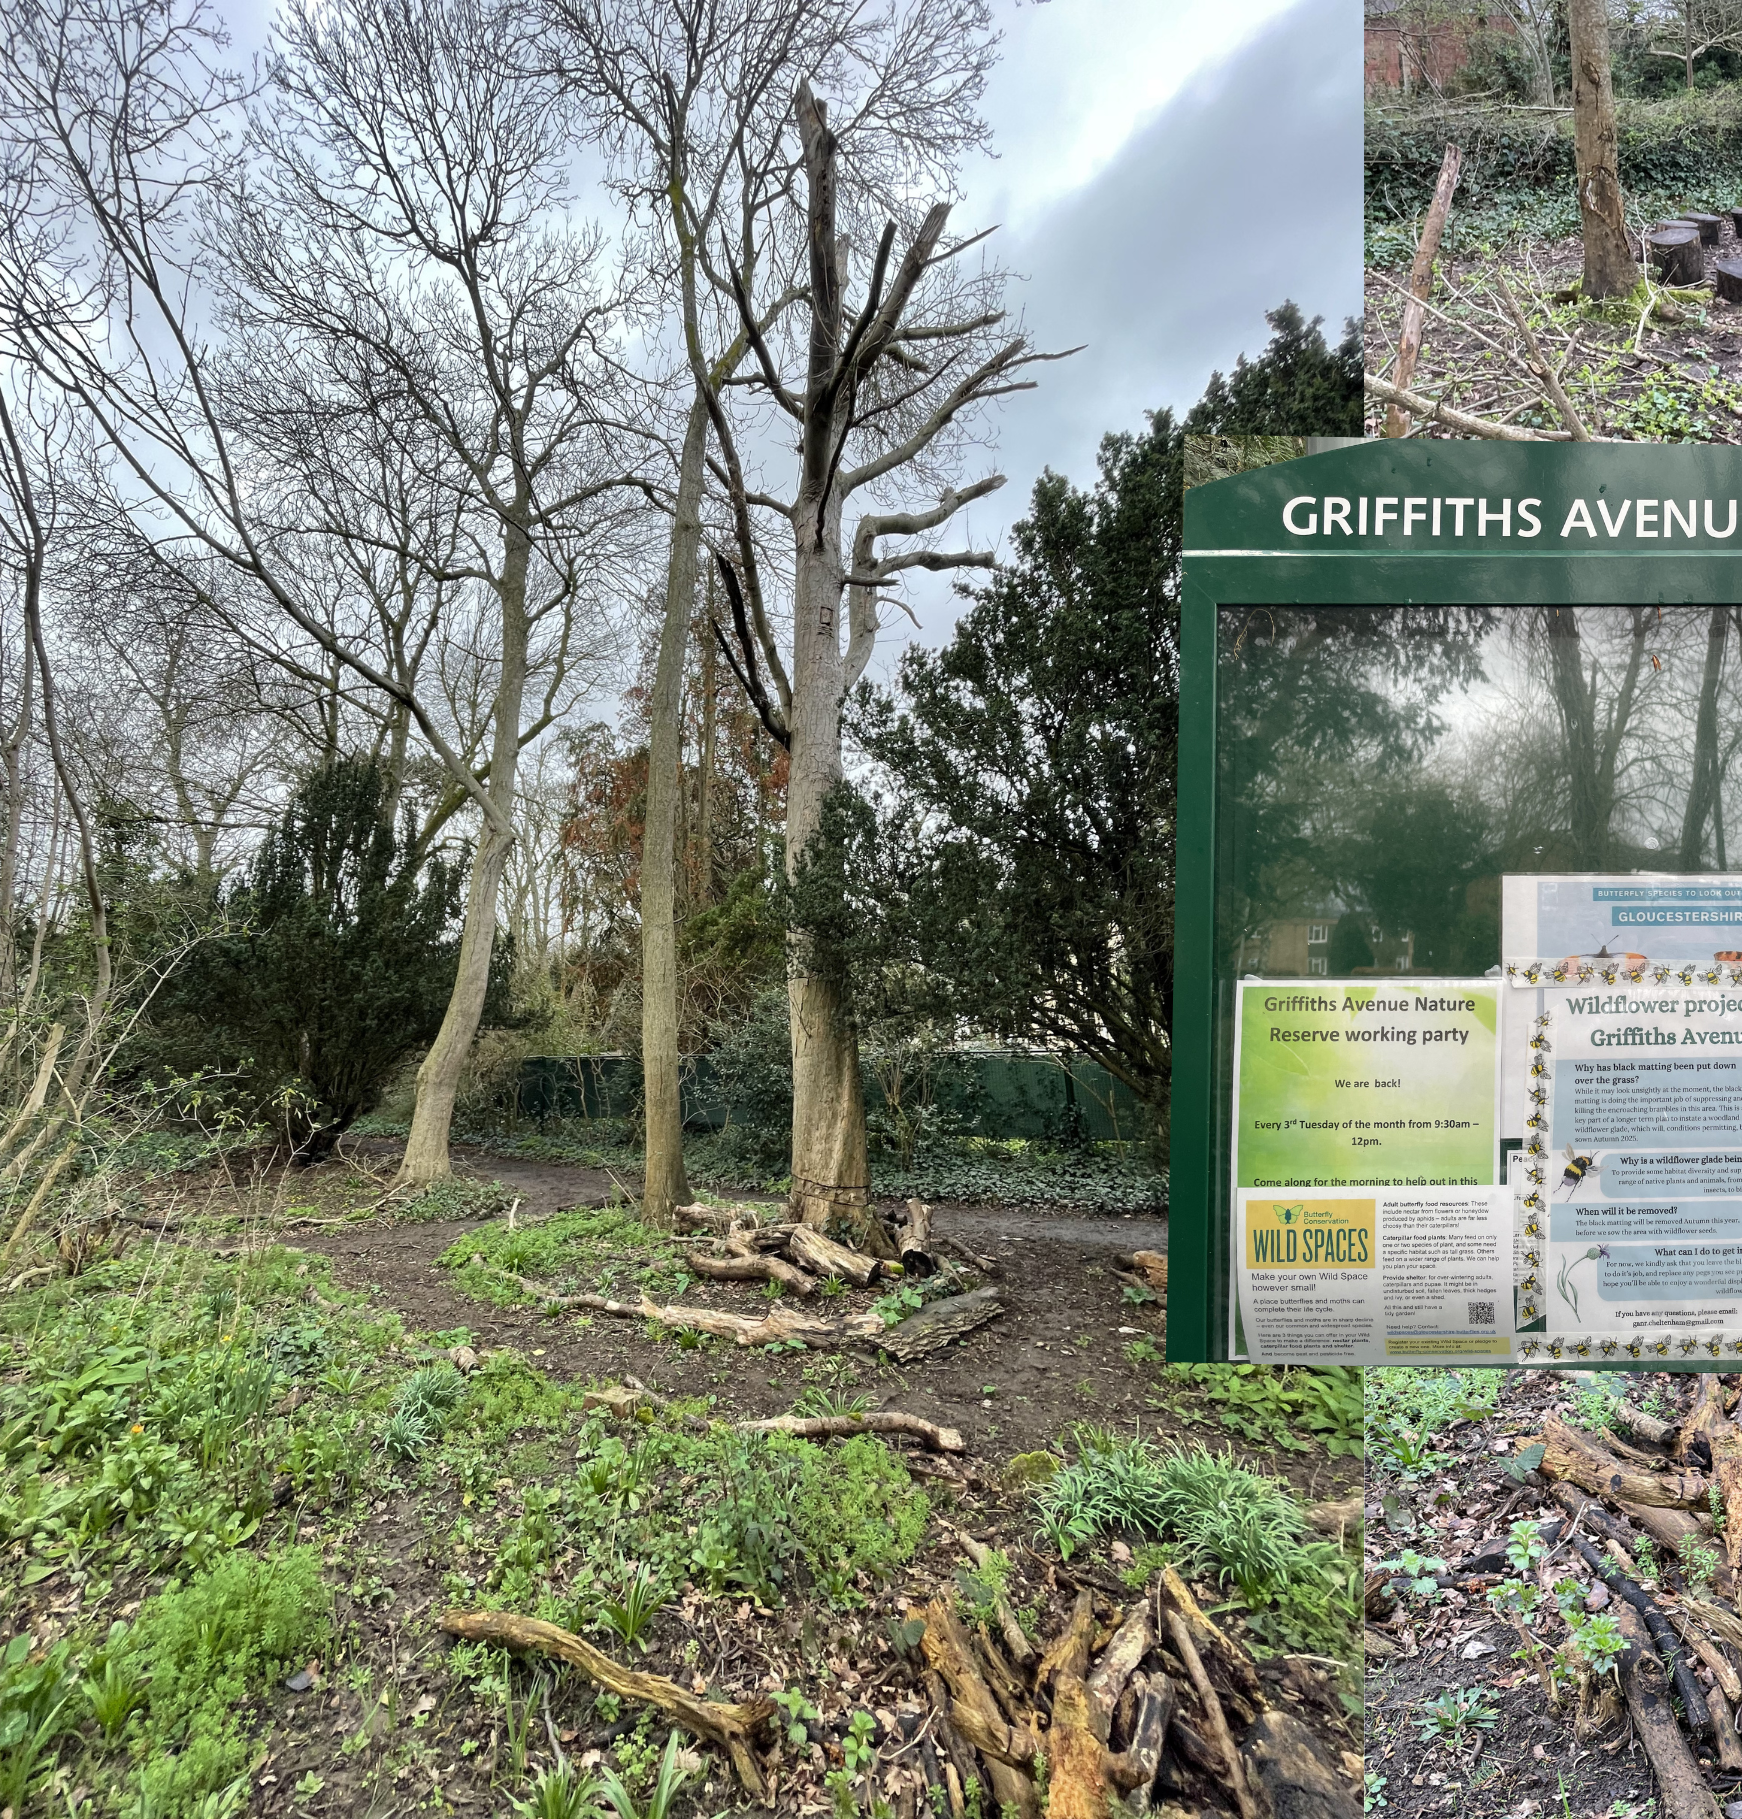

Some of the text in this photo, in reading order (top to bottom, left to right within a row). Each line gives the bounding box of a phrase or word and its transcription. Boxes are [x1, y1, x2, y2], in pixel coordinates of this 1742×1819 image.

[1281, 496, 1542, 538] GRIFFITHS
[1647, 889, 1683, 897] SPECIES
[1698, 889, 1722, 898] LOOK
[1264, 995, 1475, 1012] Griffiths Avenue Nature
[1566, 994, 1680, 1015] Wildflower
[1270, 1026, 1469, 1045] Reserve working party
[1590, 1027, 1677, 1047] Griffiths
[1574, 1061, 1737, 1074] Why has black matting been put down
[1334, 1079, 1351, 1088] We
[1374, 1078, 1401, 1088] back!
[1596, 1075, 1610, 1084] the
[1612, 1075, 1640, 1086] grass?
[1574, 1087, 1594, 1095] While
[1601, 1088, 1615, 1096] may
[1631, 1086, 1661, 1095] unsightly
[1574, 1097, 1600, 1106] matting
[1607, 1096, 1627, 1105] doing
[1640, 1096, 1673, 1104] important
[1673, 1095, 1684, 1104] job
[1692, 1096, 1732, 1104] suppressing
[1254, 1120, 1282, 1131] Every
[1299, 1119, 1340, 1131] Tuesday
[1342, 1119, 1353, 1129] of
[1354, 1119, 1371, 1129] the
[1373, 1119, 1406, 1129] month
[1408, 1119, 1432, 1129] from
[1434, 1119, 1470, 1128] 9:30am
[1351, 1136, 1382, 1147] 12pm.
[1620, 1156, 1640, 1167] Why
[1640, 1156, 1648, 1164] is
[1655, 1155, 1700, 1164] wildflower
[1700, 1155, 1723, 1166] glade
[1253, 1176, 1478, 1188] Come along for the morning to help out in this
[1304, 1210, 1333, 1219] Butterfly
[1575, 1206, 1678, 1216] When will it be removed?
[1253, 1228, 1368, 1263] WILD SPACES
[1654, 1247, 1676, 1256] What
[1699, 1247, 1711, 1255] do
[1722, 1248, 1735, 1256] get
[1251, 1272, 1276, 1281] Make
[1277, 1274, 1297, 1282] your
[1318, 1272, 1338, 1281] Wild
[1340, 1272, 1368, 1282] Space
[1252, 1283, 1316, 1292] however small!
[1615, 1310, 1622, 1318] If
[1664, 1309, 1697, 1317] questions,
[1697, 1308, 1718, 1316] please
